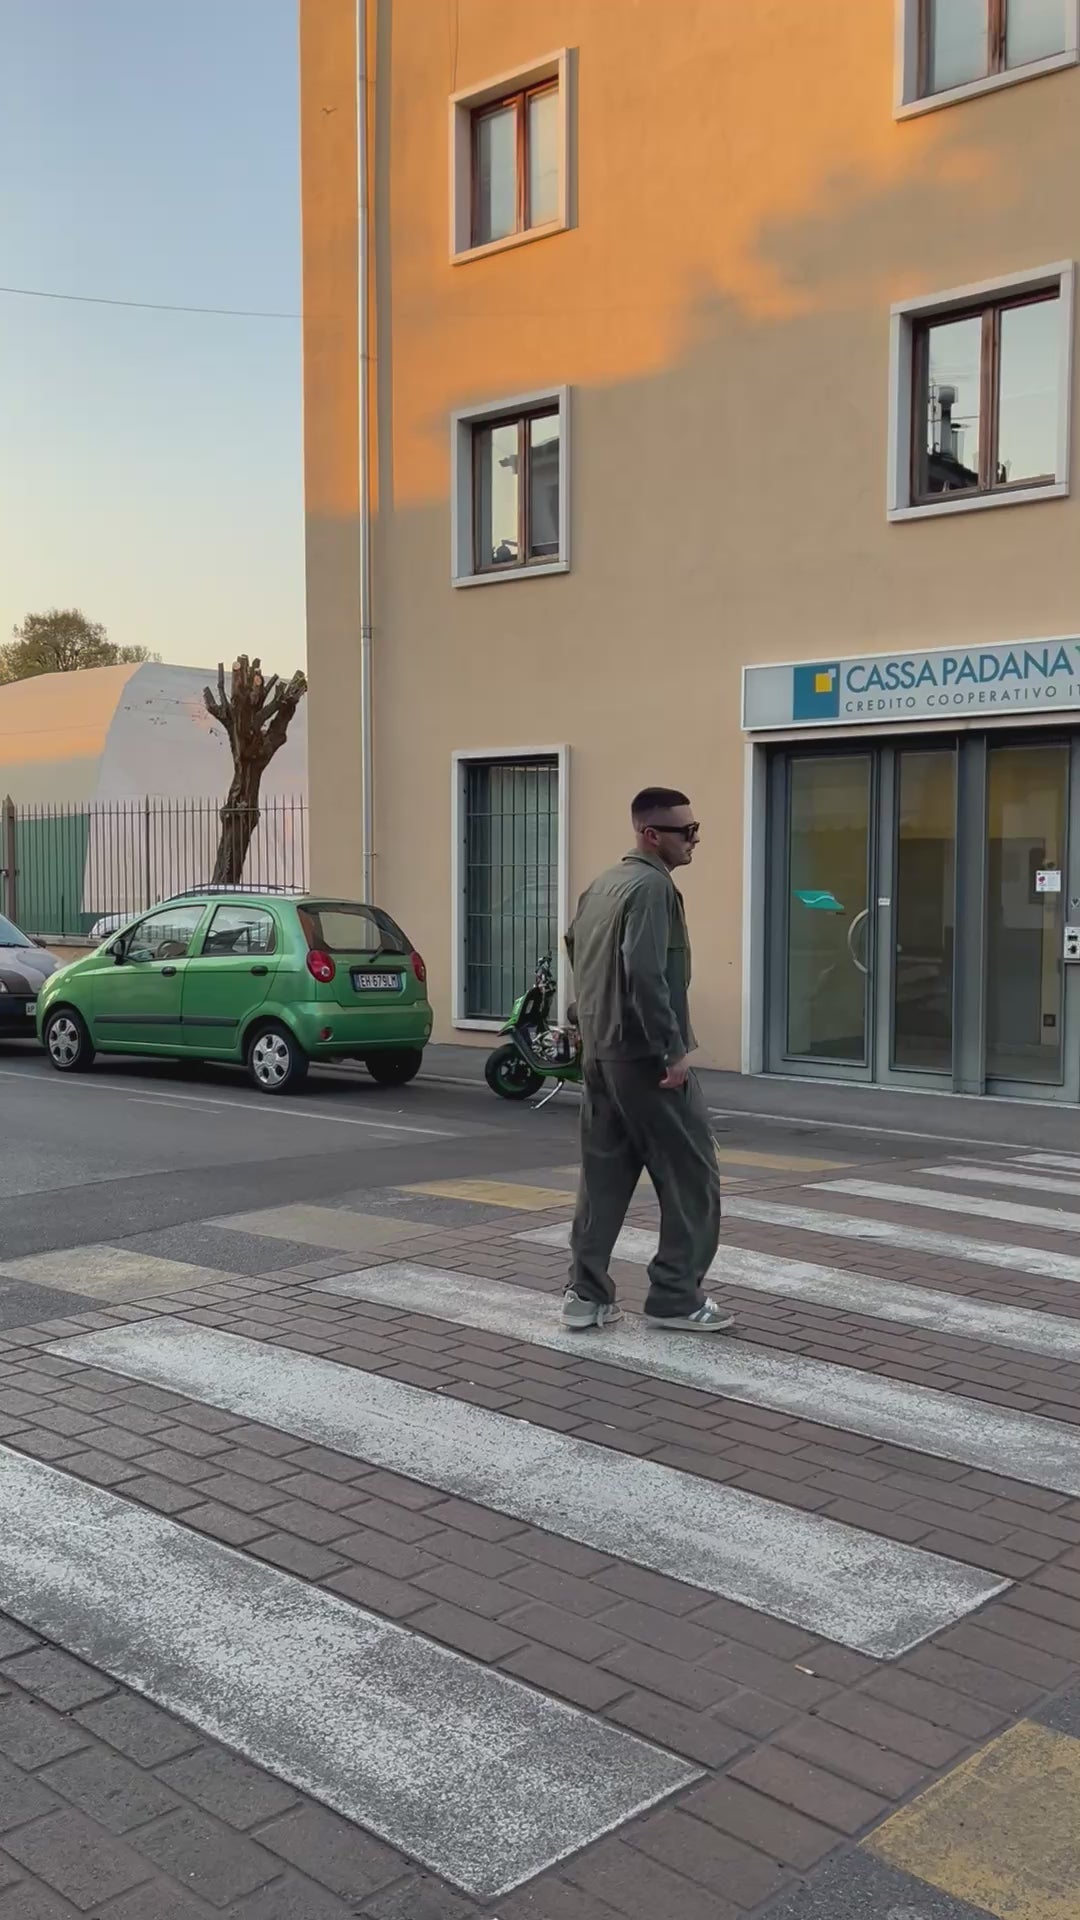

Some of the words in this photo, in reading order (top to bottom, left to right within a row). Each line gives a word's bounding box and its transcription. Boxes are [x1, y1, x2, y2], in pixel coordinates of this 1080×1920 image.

[846, 659, 938, 693] CASSA
[943, 645, 1074, 685] PADANA
[845, 697, 916, 712] CREDITO
[926, 685, 1057, 706] COOPERATIVO
